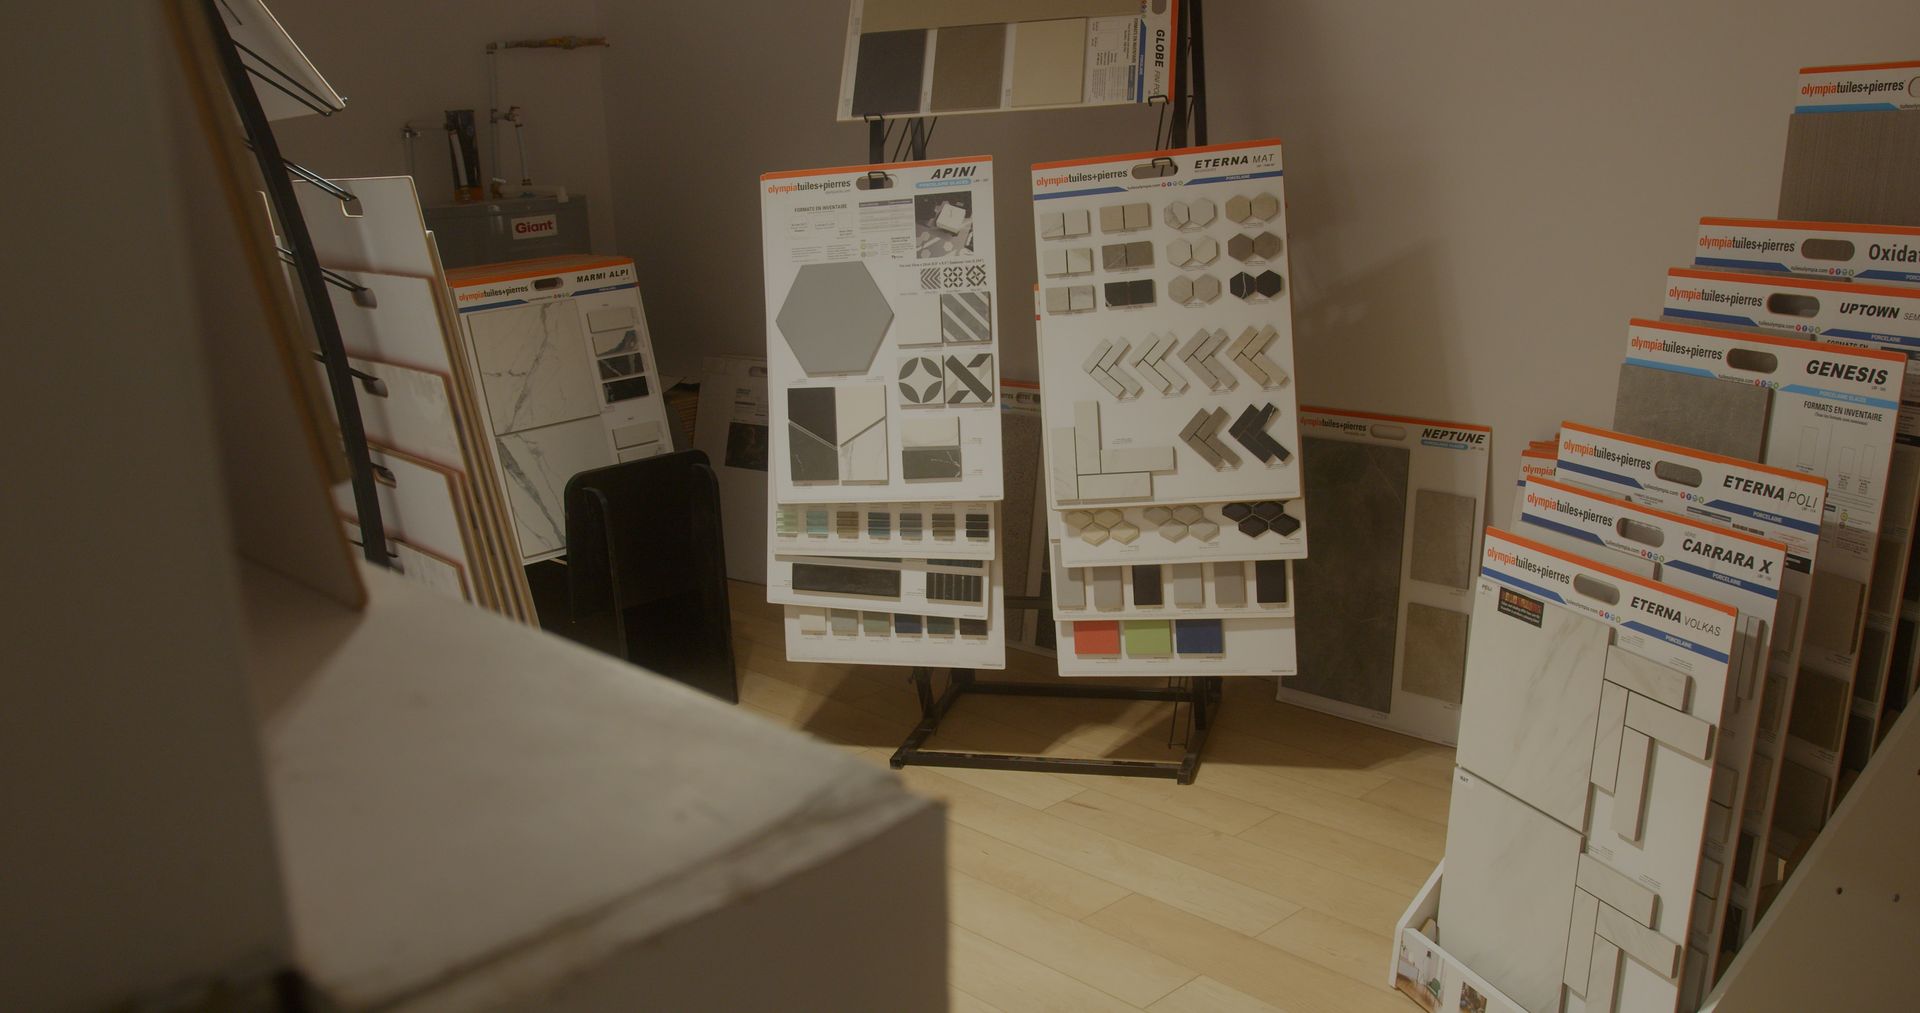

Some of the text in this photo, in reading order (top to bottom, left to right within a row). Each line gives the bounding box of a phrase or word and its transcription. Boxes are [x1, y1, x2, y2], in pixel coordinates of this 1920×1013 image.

[1154, 30, 1165, 68] GLOBE
[1801, 80, 1904, 96] olympiatuiles+pierres
[1194, 156, 1248, 169] ETERNA
[1252, 154, 1274, 164] MAT
[931, 166, 976, 179] APINI
[1036, 170, 1128, 186] olympiatuiles+pierres
[768, 180, 851, 194] olympiatuiles+pierres
[515, 220, 553, 234] Giant
[1699, 235, 1795, 254] olympiatuiles+pierres
[1868, 244, 1920, 263] Oxida
[576, 268, 629, 283] MARMI ALPI
[458, 286, 529, 302] olympiatuiles+pierres
[1668, 286, 1763, 307] olympiatuiles+pierres
[1840, 302, 1900, 319] UPTOWN
[1631, 337, 1724, 360] olympiatuiles+pierres
[1806, 360, 1888, 385] GENESIS
[1804, 400, 1833, 413] FORMATS
[1834, 406, 1843, 414] EN
[1844, 408, 1882, 422] INVENTAIRE
[1422, 428, 1486, 444] NEPTUNE
[1563, 438, 1652, 471] olympiatuiles+pierres
[1723, 475, 1818, 509] ETERNA POLI
[1527, 492, 1613, 527] olympiatuiles+pierres
[1682, 538, 1774, 574] CARRARA X
[1487, 548, 1571, 584] olympiatuiles+pierres
[1630, 596, 1721, 637] ETERNA VOLKAS
